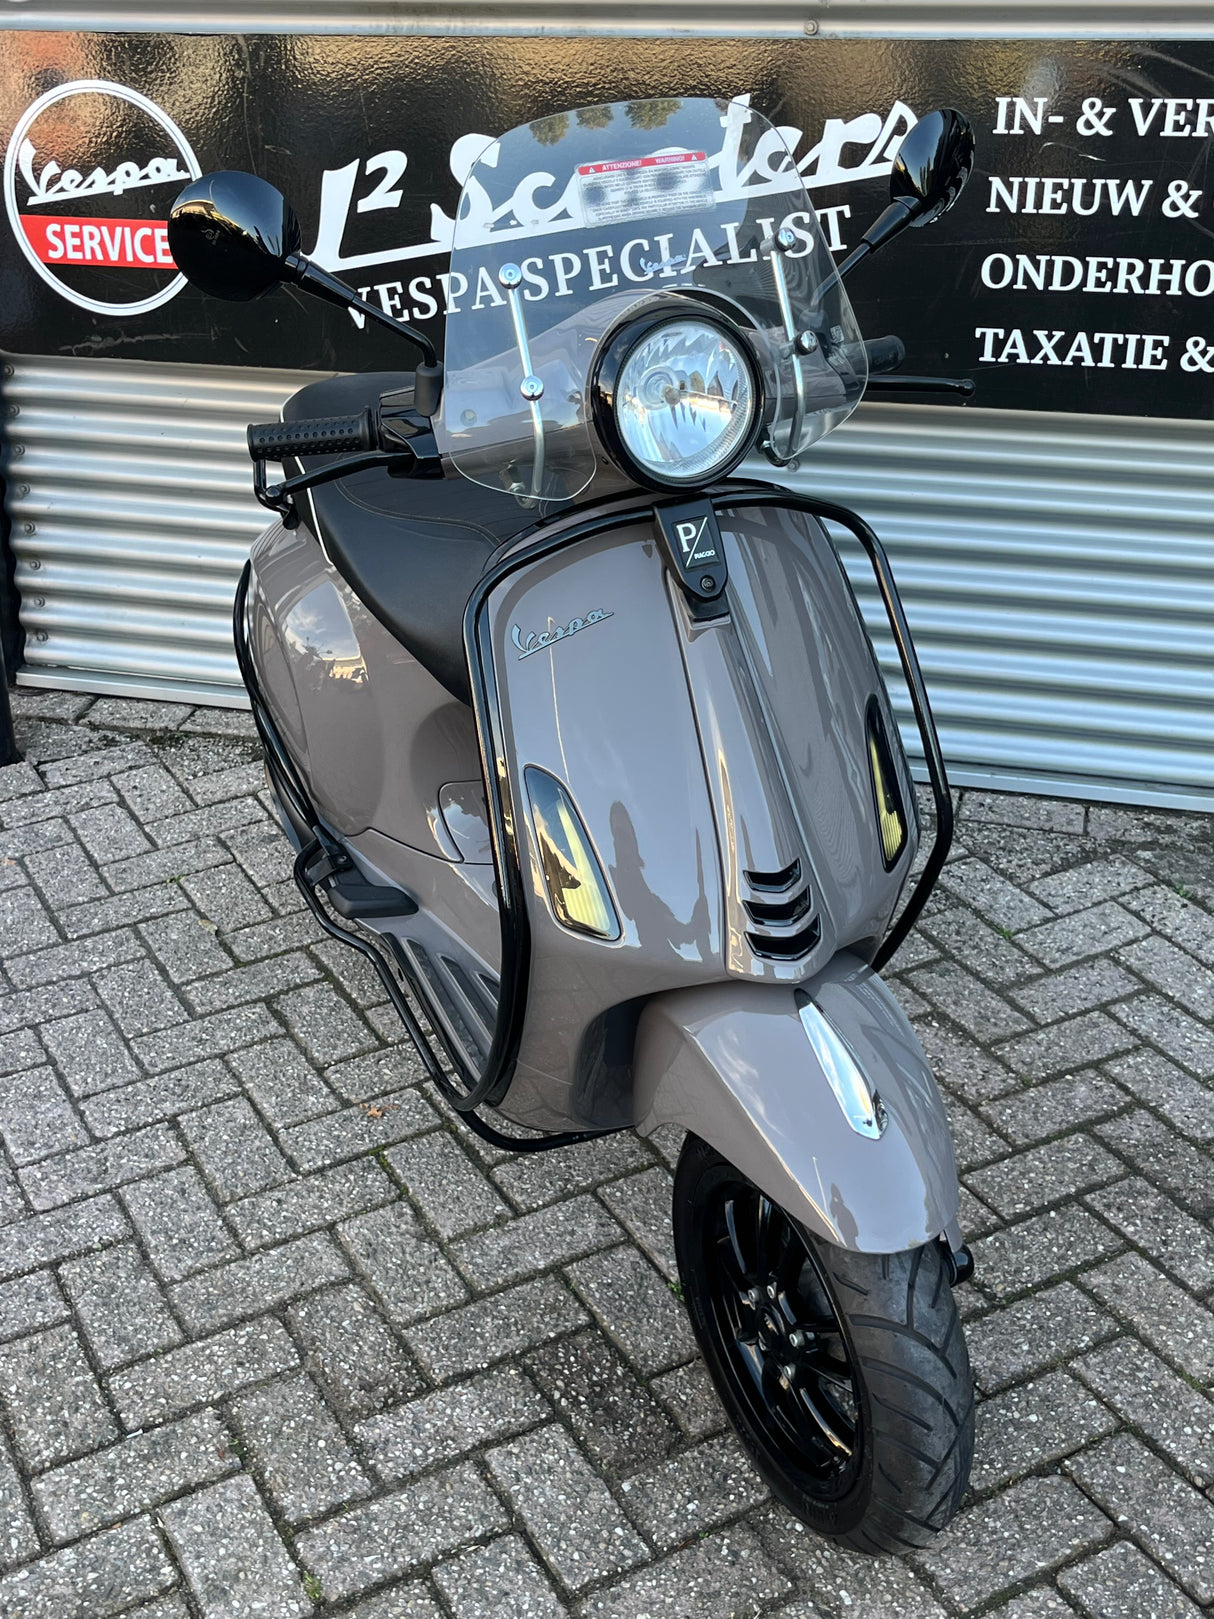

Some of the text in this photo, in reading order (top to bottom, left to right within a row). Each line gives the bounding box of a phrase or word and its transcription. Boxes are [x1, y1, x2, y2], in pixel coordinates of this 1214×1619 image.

[992, 96, 1065, 136] IN-
[1076, 97, 1117, 137] &
[18, 138, 191, 207] Vespa
[601, 159, 642, 171] ATTENZIONE!
[986, 176, 1203, 219] NIEUW &
[45, 223, 174, 265] SERVICE
[519, 204, 852, 301] SPECIALIST
[980, 253, 1214, 297] ONDERHO
[975, 327, 1214, 373] TAXATIE &
[676, 522, 697, 553] P
[511, 607, 615, 661] Vespa
